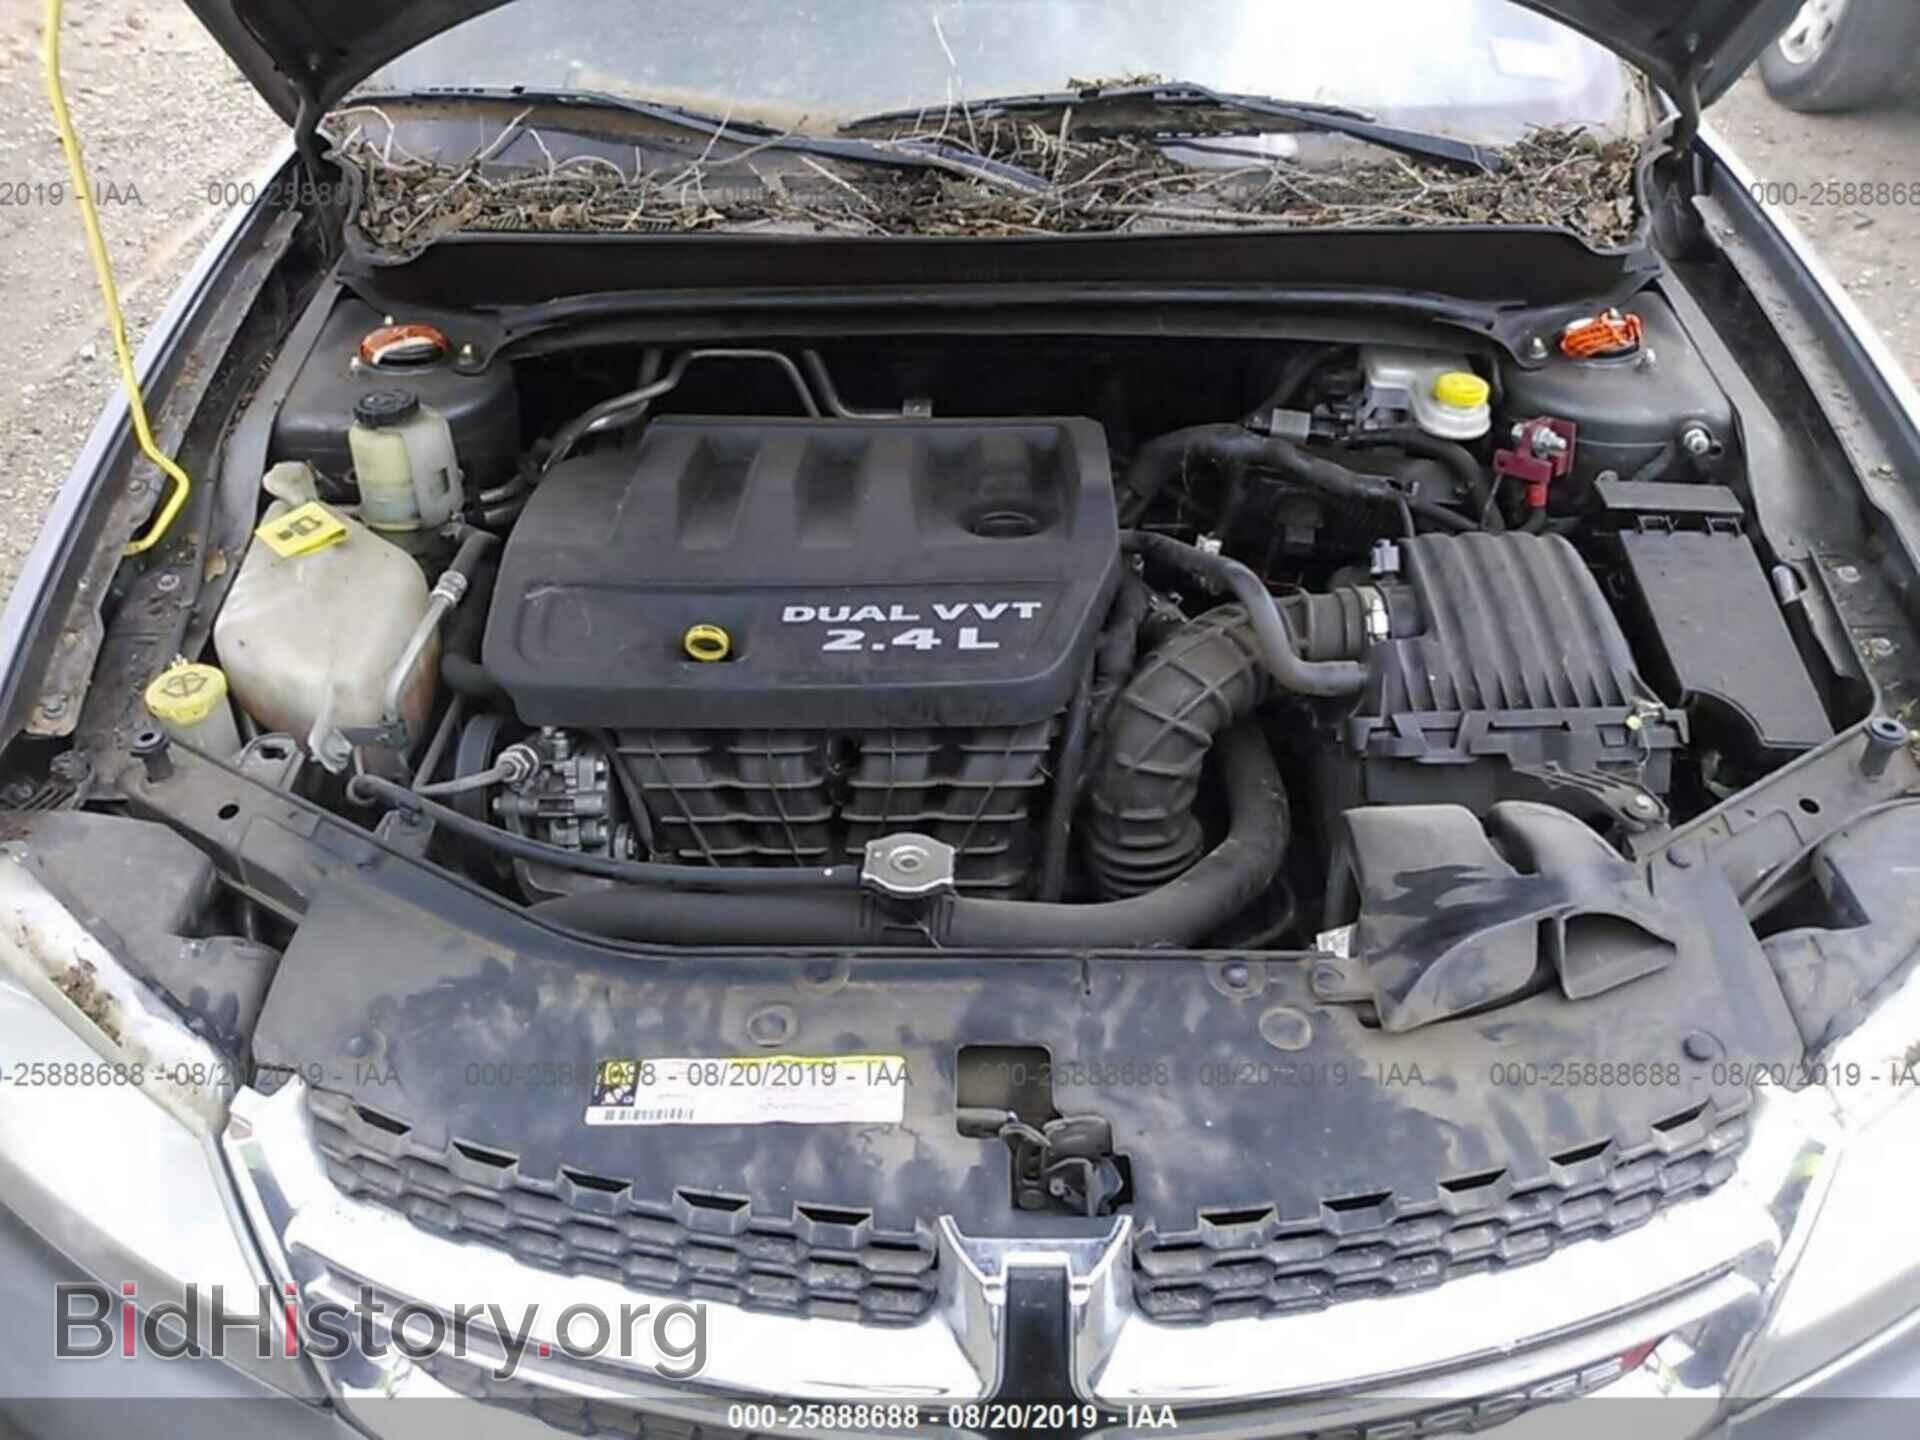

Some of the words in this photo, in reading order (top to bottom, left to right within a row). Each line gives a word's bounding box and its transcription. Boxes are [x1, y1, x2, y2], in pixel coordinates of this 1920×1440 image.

[782, 604, 921, 623] DUAL
[933, 602, 1042, 622] VVT
[822, 628, 942, 651] 2.4
[958, 627, 1000, 650] L
